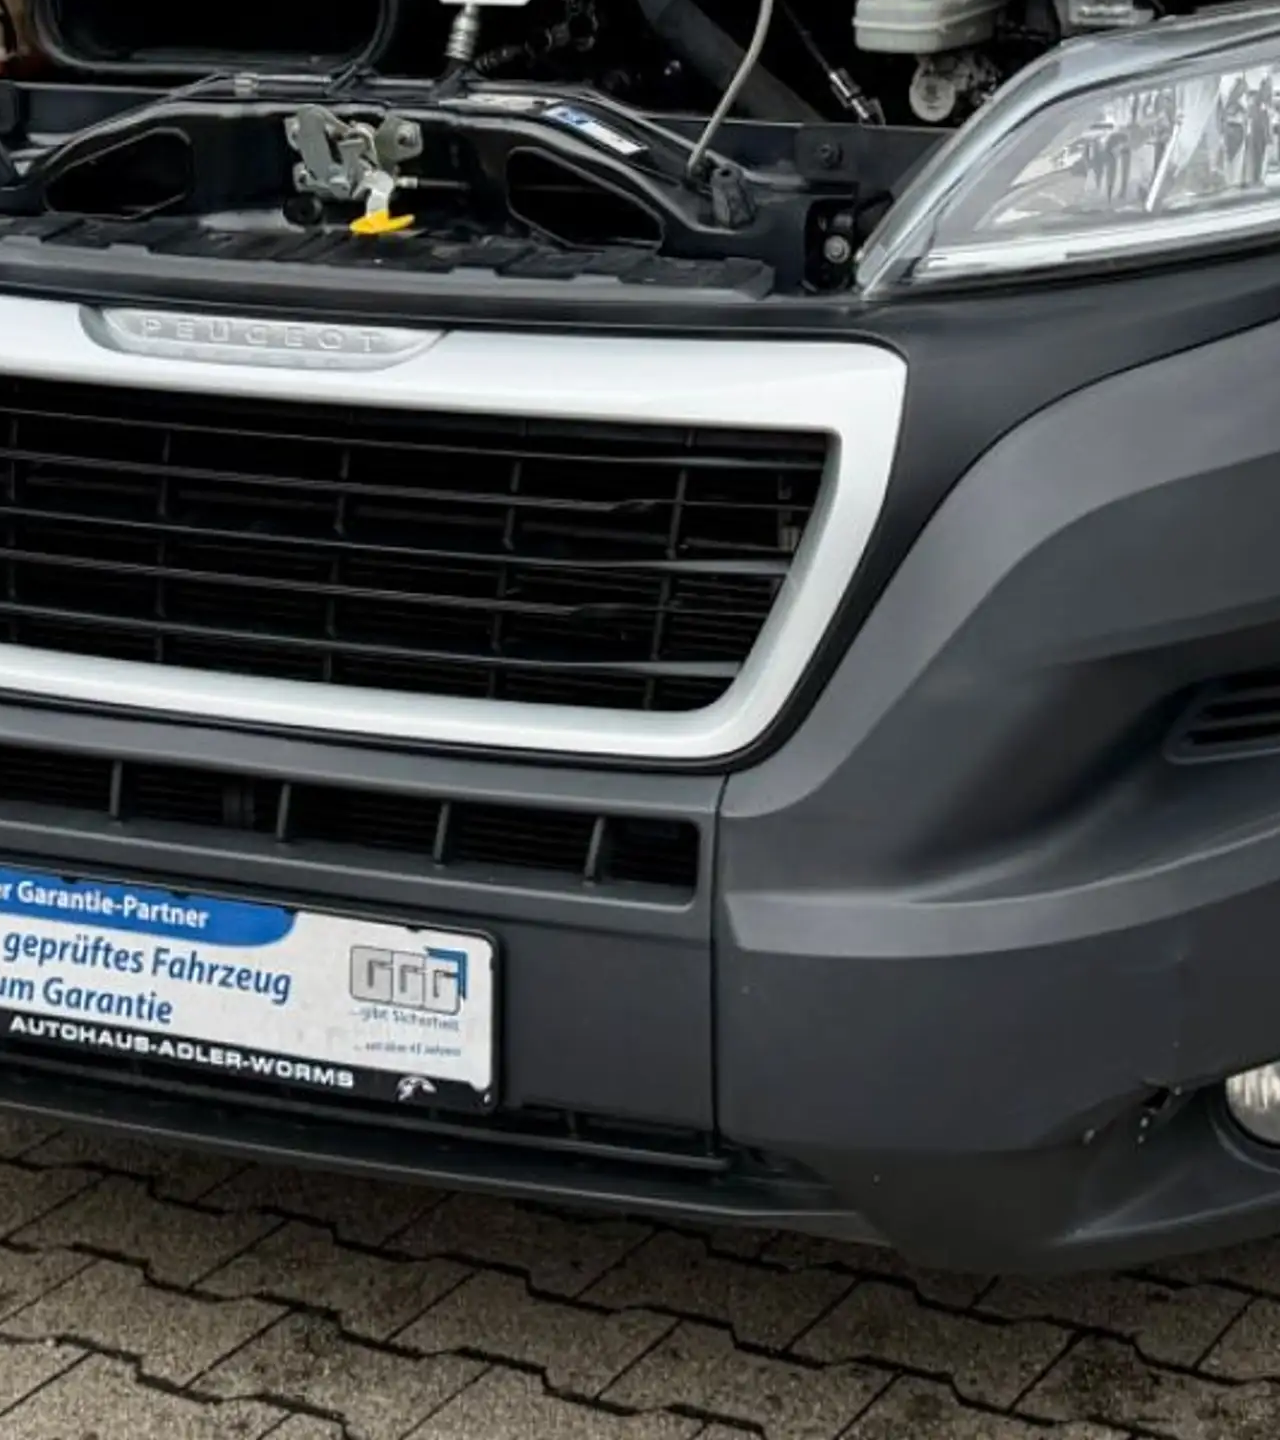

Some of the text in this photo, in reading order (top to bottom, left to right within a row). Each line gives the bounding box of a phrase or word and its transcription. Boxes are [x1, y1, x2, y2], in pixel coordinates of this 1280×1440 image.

[140, 315, 383, 354] PEUGEOT
[16, 880, 211, 930] Garantie-Partner
[3, 929, 293, 1006] geprüftes Fahrzeug
[42, 976, 175, 1026] Garantie
[9, 1015, 355, 1089] AUTOHAUS-ADLER-WORMS
